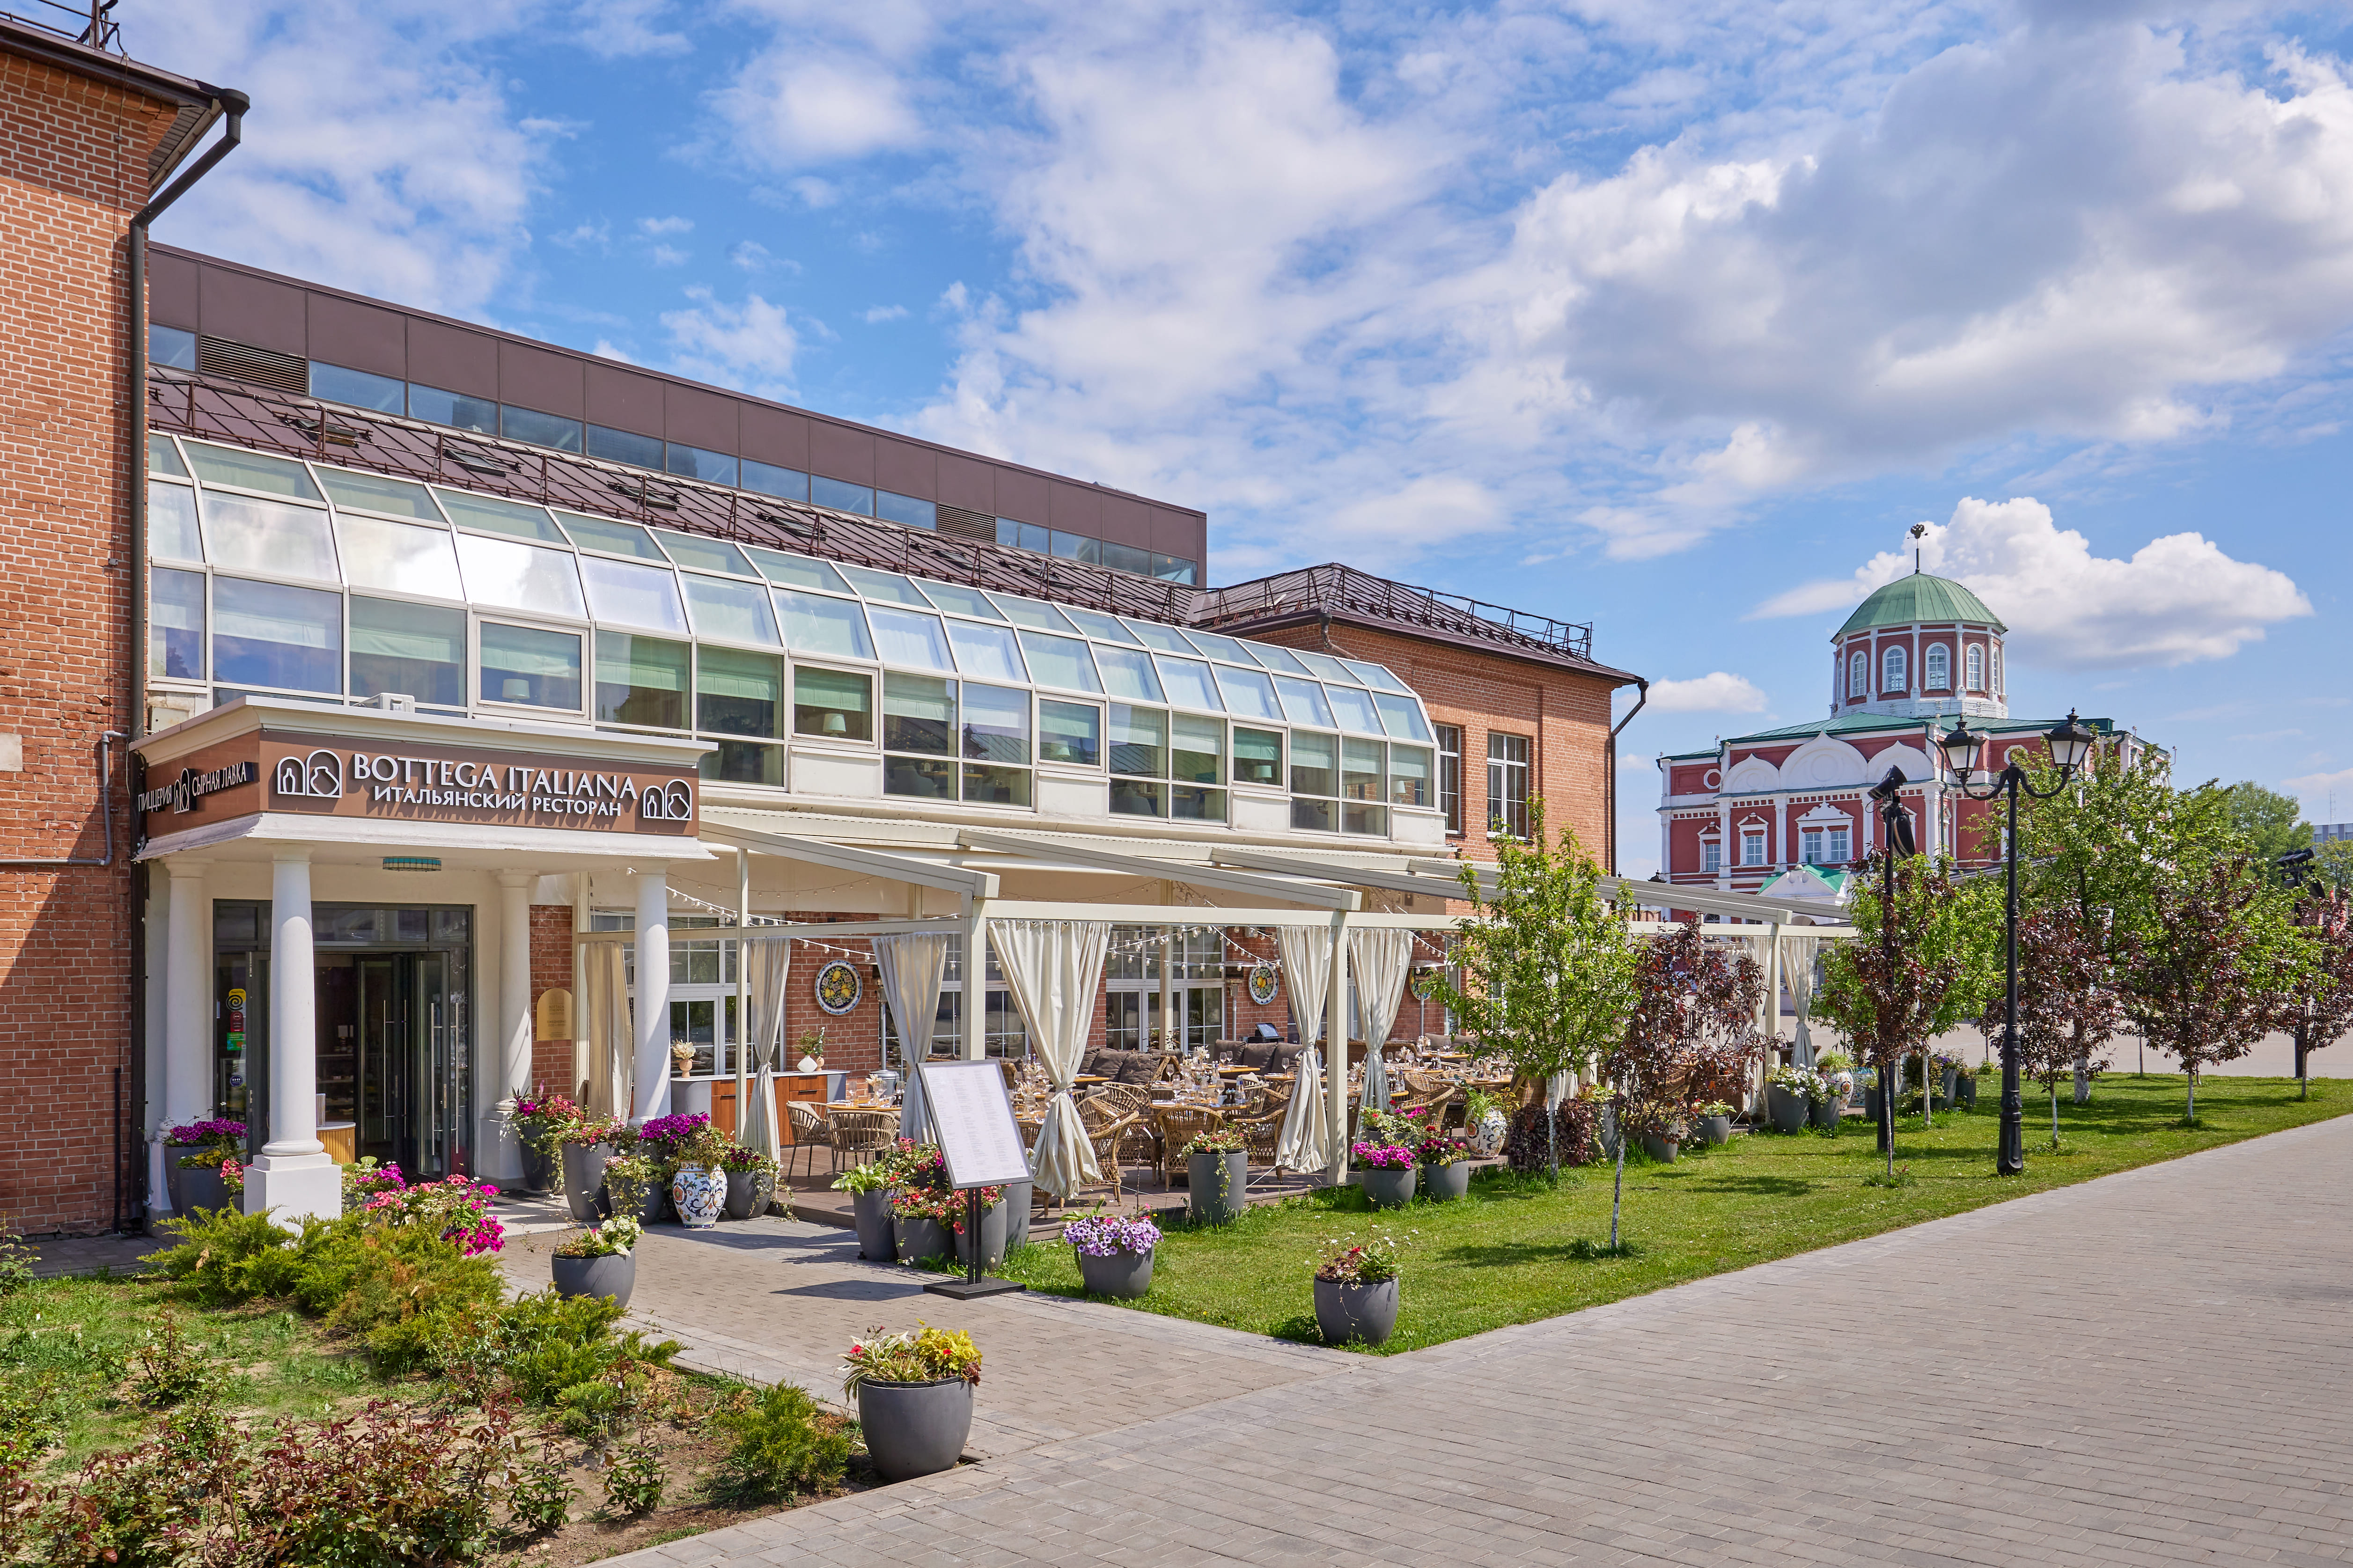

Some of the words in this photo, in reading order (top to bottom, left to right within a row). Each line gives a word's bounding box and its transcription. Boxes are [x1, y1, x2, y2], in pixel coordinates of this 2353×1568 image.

[138, 784, 172, 813] ПИЦЦЕРИЯ
[192, 769, 220, 797] СЫРНАЯ
[221, 761, 247, 788] ЛАВКА
[354, 753, 499, 789] BOTTEGA
[509, 767, 638, 799] ITALIANA
[375, 785, 525, 810] ИТАЛЬЯНСКИЙ
[533, 797, 621, 816] РЕСТОРАН
